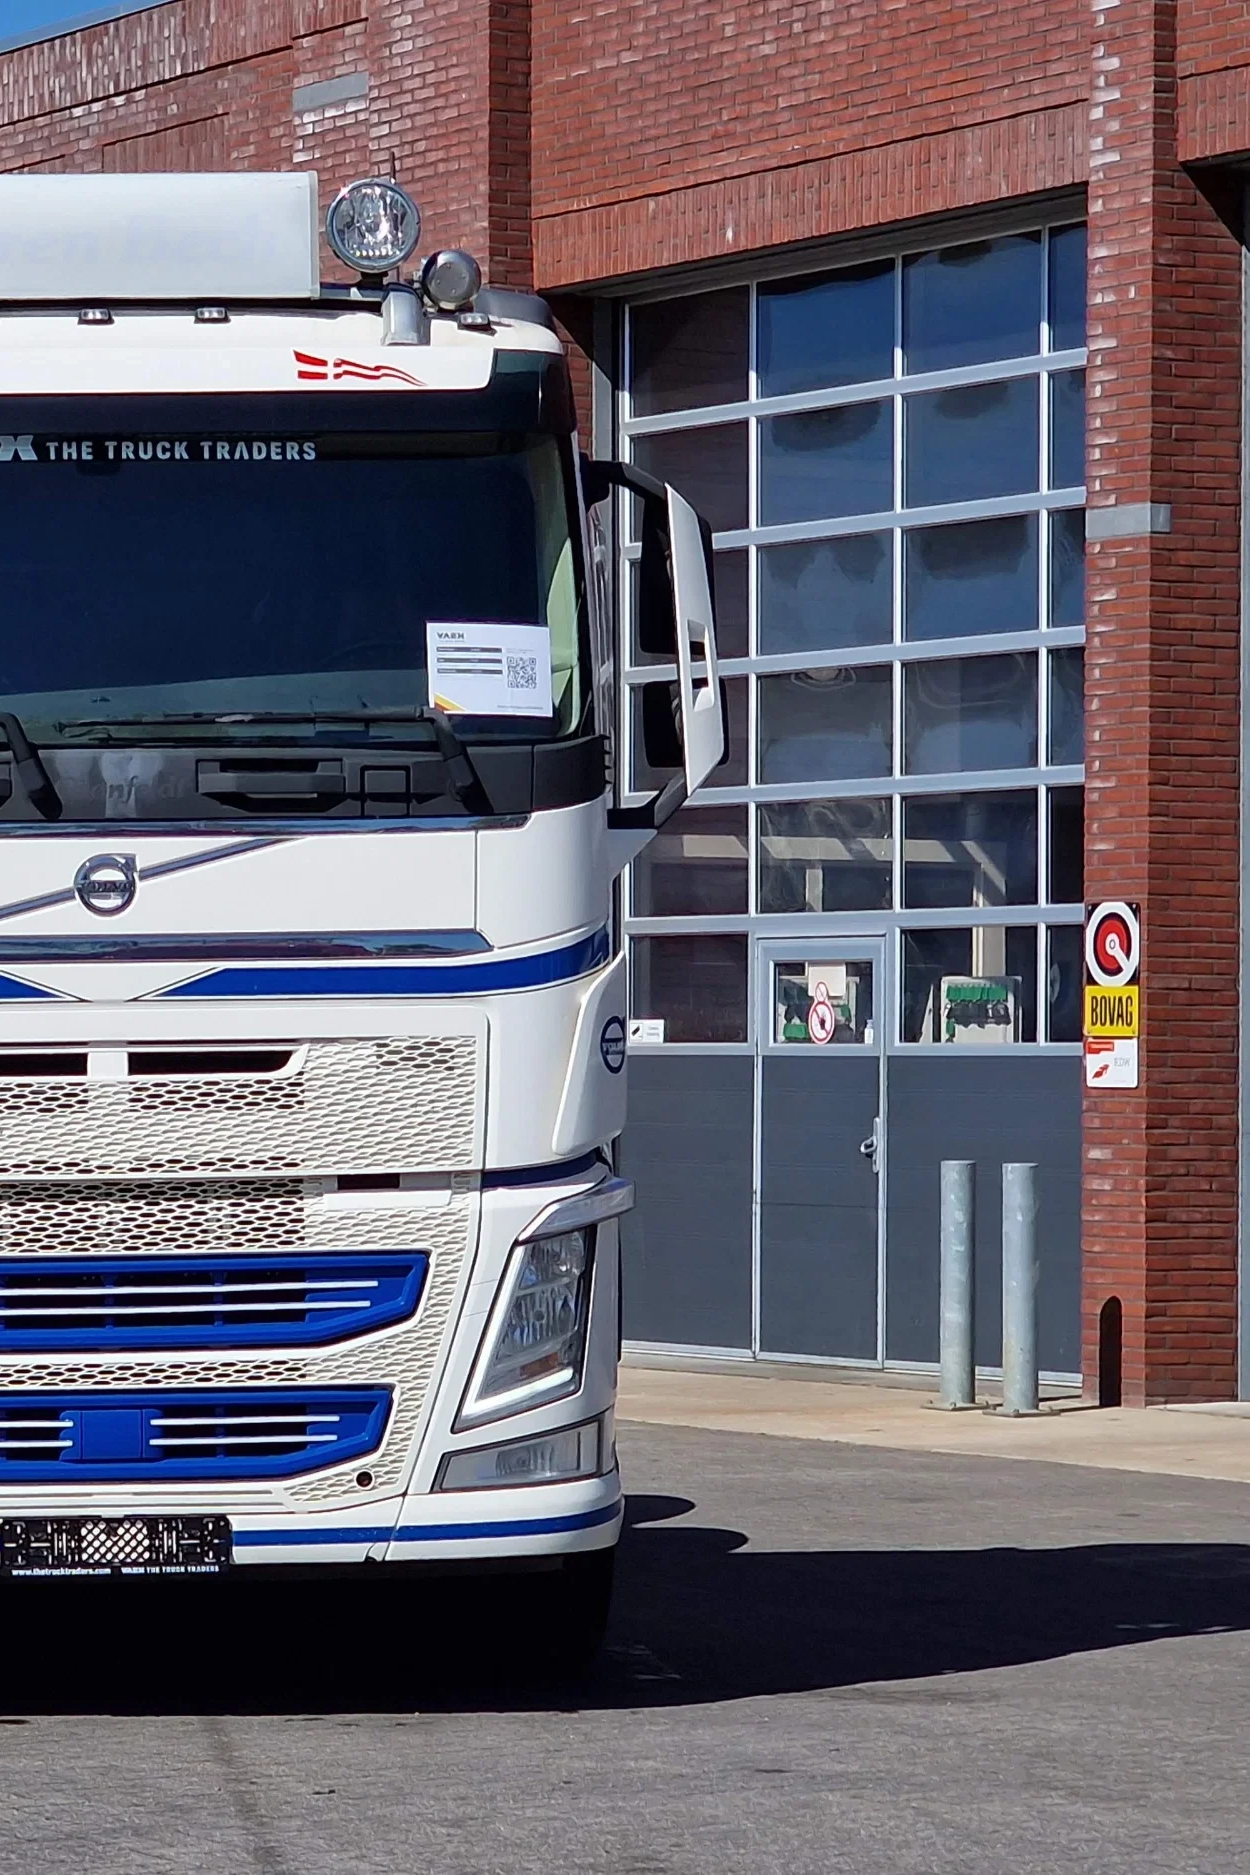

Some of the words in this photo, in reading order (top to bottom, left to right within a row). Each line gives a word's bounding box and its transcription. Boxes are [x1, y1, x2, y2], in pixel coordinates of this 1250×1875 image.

[46, 441, 94, 461] THE
[106, 441, 190, 461] TRUCK
[200, 441, 317, 461] TRADERS
[1091, 994, 1134, 1027] BOVAG
